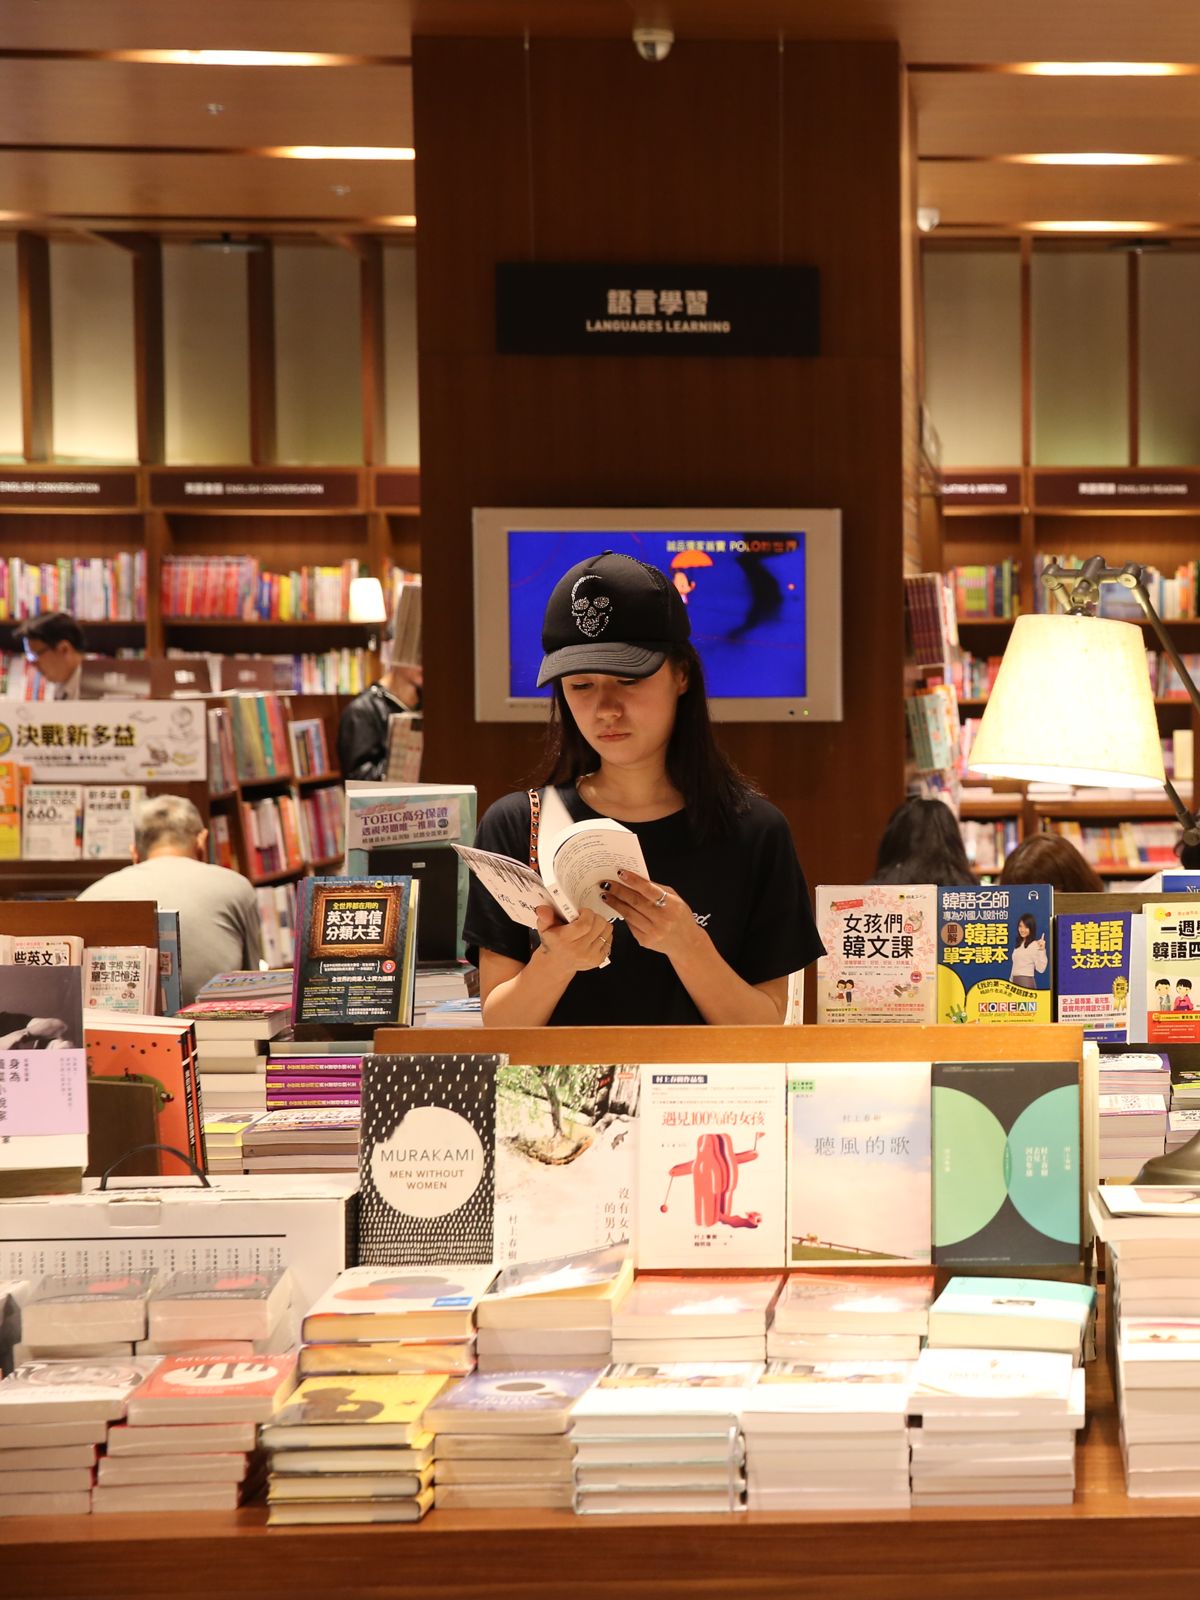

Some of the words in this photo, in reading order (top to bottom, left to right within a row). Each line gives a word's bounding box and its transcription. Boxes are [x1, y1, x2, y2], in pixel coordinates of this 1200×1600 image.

[607, 289, 708, 316] 語言學習
[586, 320, 663, 332] LANGUAGES
[665, 321, 731, 333] LEARNING
[16, 724, 135, 748] 決戰新多益
[361, 807, 449, 826] TOEIC高分保證
[942, 891, 1010, 910] 韓語名師
[327, 911, 383, 926] 英文書信
[943, 911, 1009, 921] 專為外國人設計的
[326, 926, 381, 941] 分類大全
[964, 923, 1009, 946] 韓語
[1071, 920, 1124, 953] 韓語
[843, 935, 914, 959] 韓文課
[943, 949, 1009, 965] 單字課本
[1072, 952, 1122, 969] 文法大全
[91, 971, 141, 982] 單字記憶法
[978, 1002, 1037, 1012] KOREAN
[662, 1111, 766, 1126] 遇見100%的女孩
[815, 1136, 910, 1156] 聽風的歌
[381, 1149, 475, 1163] MURAKAMI
[389, 1170, 412, 1179] MEN
[416, 1170, 464, 1179] WITHOUT
[407, 1181, 448, 1190] WOMEN
[618, 1188, 629, 1242] 沒有女人
[604, 1204, 616, 1244] 的男人
